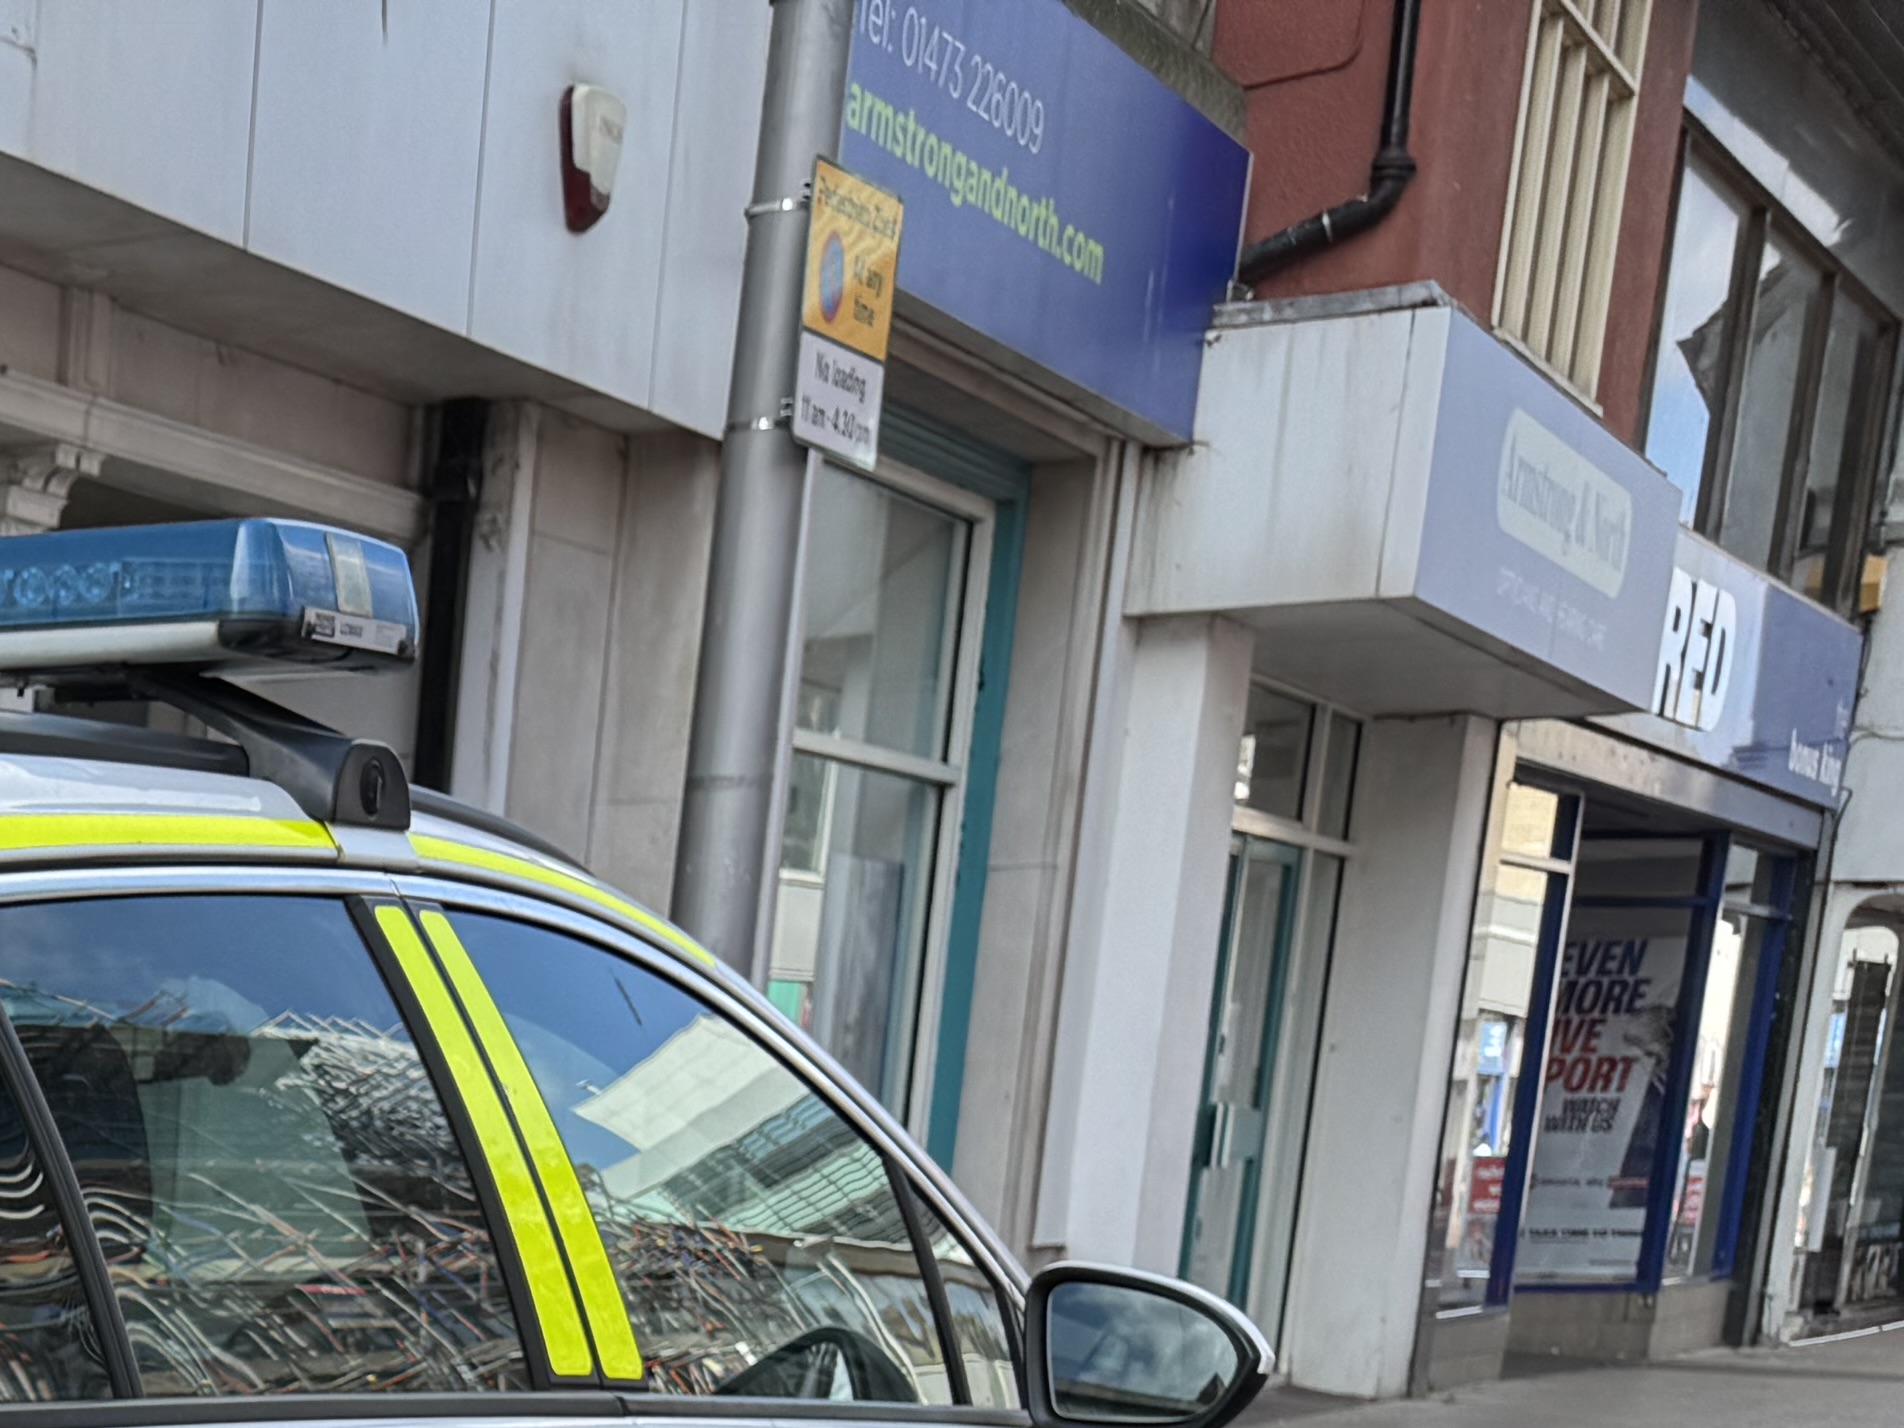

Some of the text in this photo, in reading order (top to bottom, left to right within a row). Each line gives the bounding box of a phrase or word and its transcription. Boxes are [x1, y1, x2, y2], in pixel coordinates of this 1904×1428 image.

[901, 7, 966, 100] 01473
[966, 54, 1046, 155] 226009
[845, 81, 1105, 285] armstrongandnorth.com
[814, 350, 867, 405] No loading
[1550, 1018, 1607, 1056] IVE
[1545, 1056, 1636, 1095] PORT
